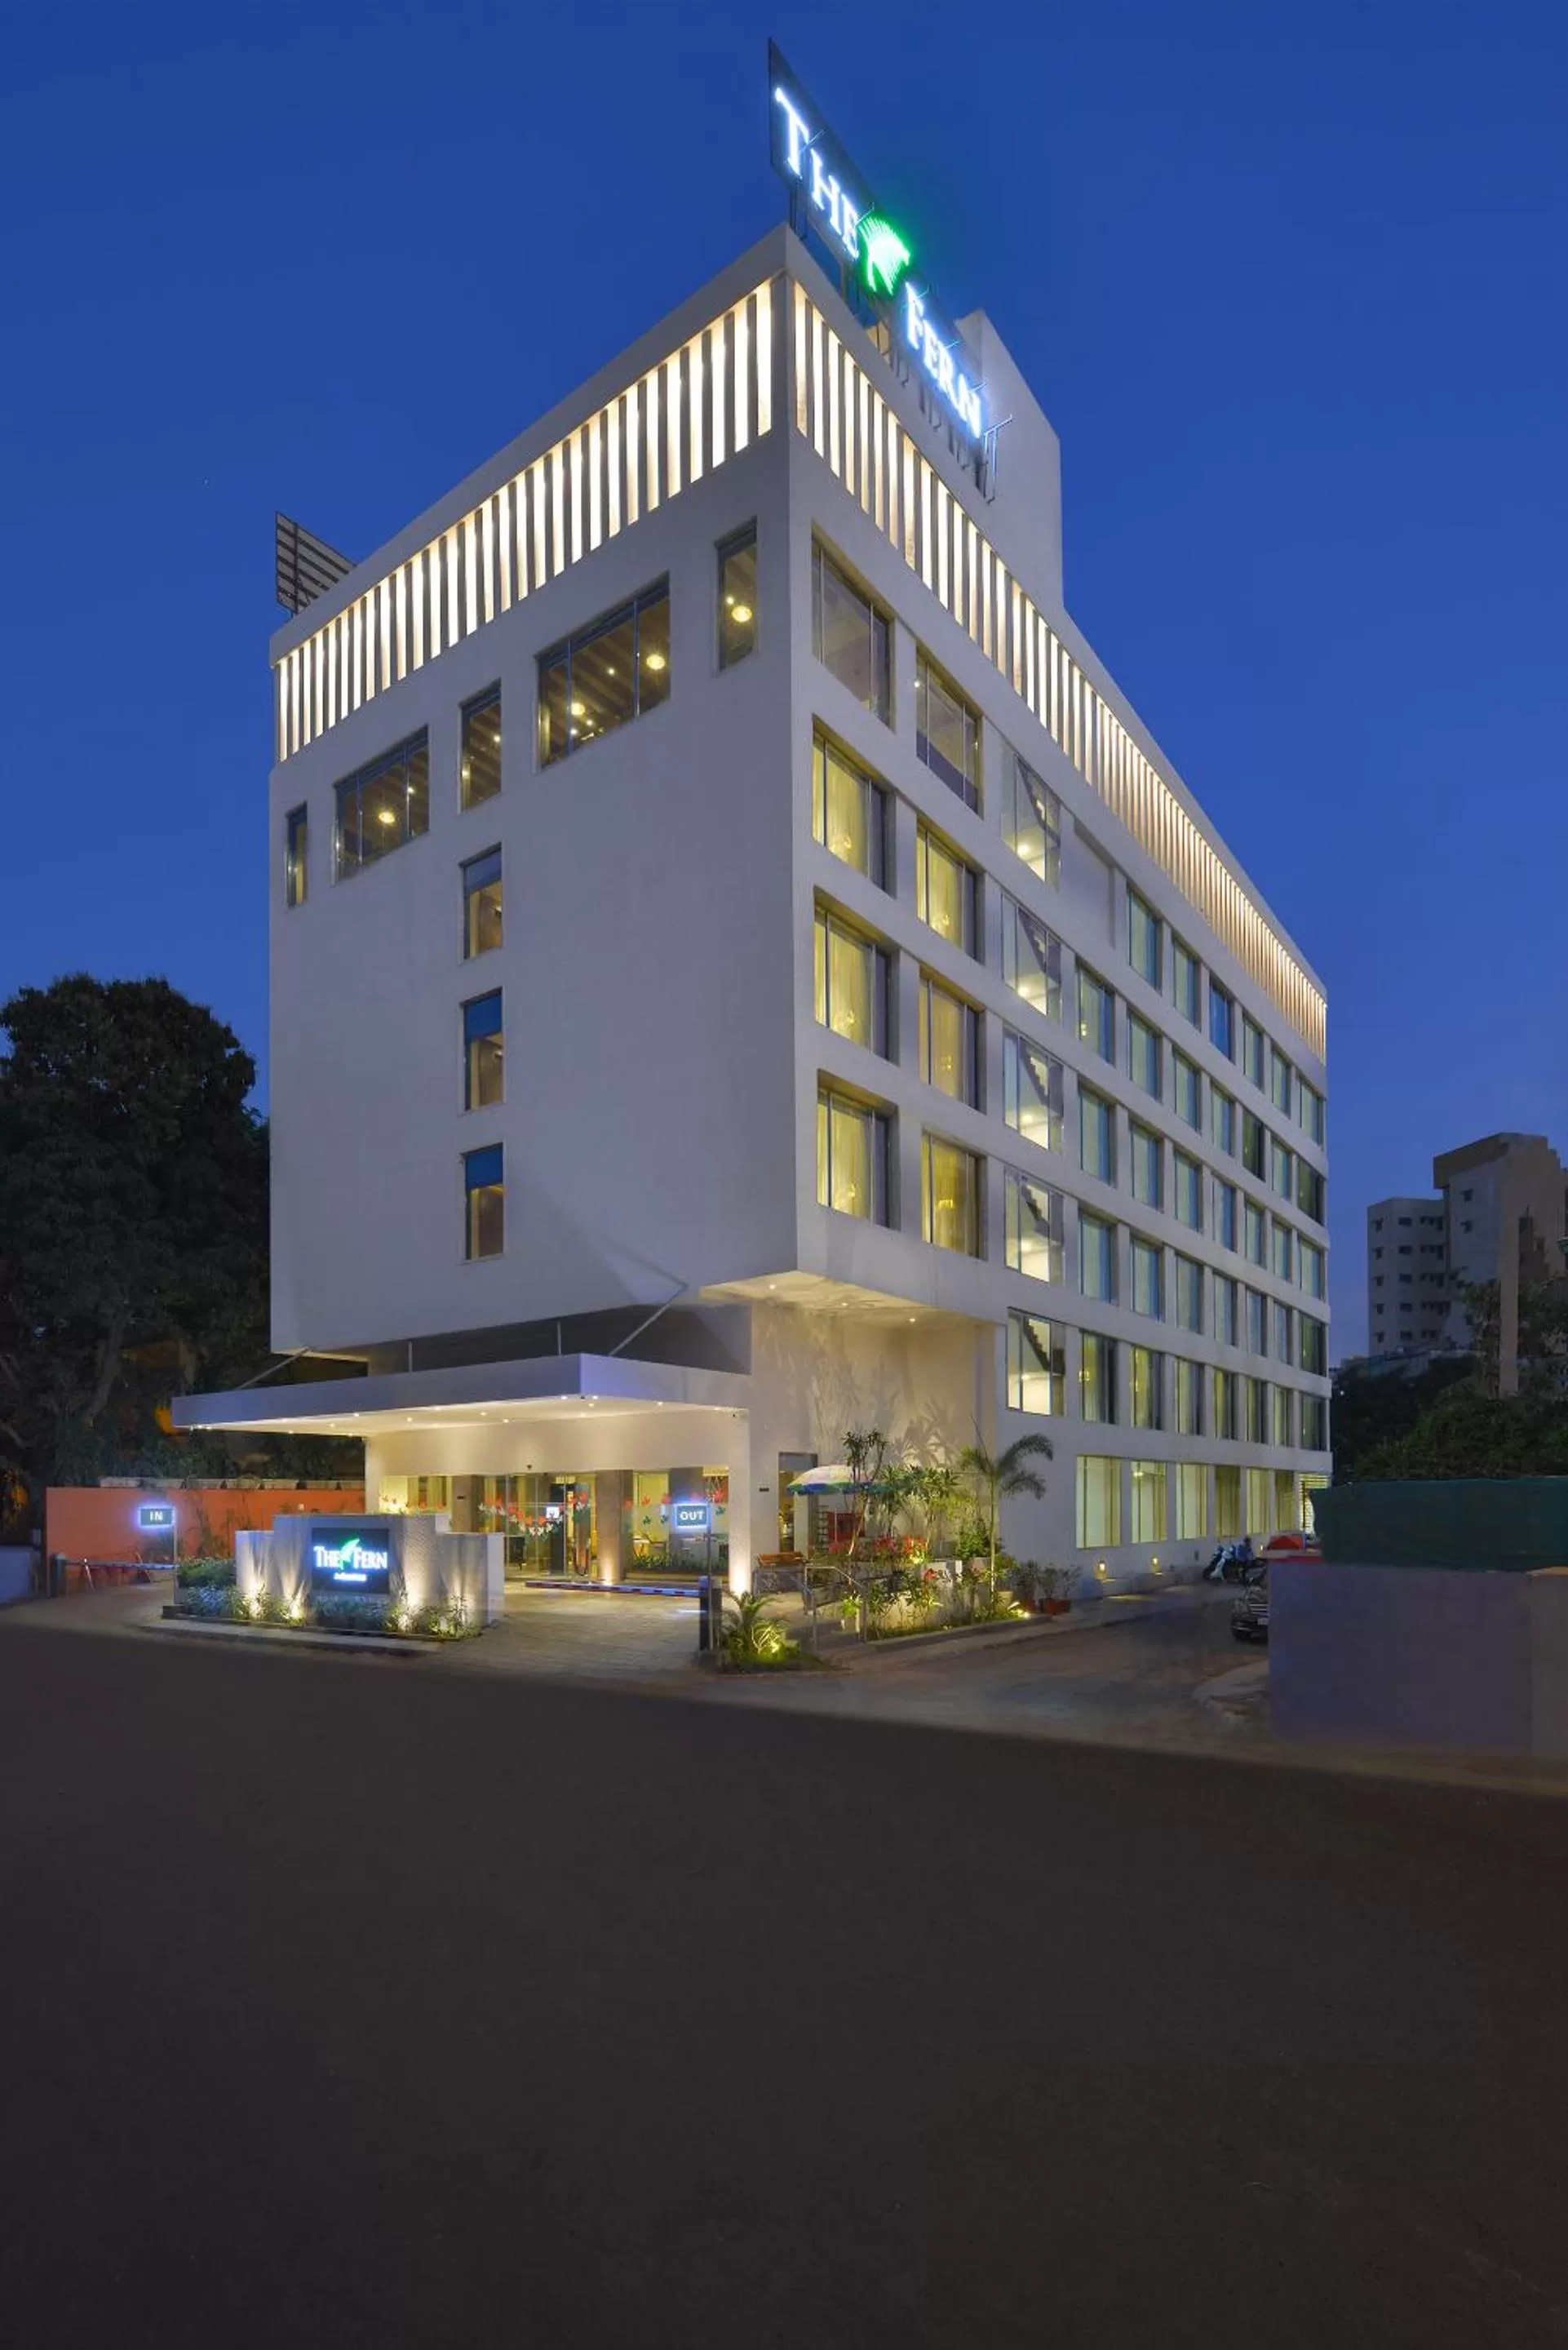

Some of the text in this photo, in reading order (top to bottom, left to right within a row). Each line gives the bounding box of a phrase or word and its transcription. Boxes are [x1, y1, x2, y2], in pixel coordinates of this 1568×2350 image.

[775, 86, 981, 439] THE FERN
[150, 1511, 163, 1521] IN
[680, 1510, 705, 1520] OUT
[313, 1545, 388, 1568] THE FERN
